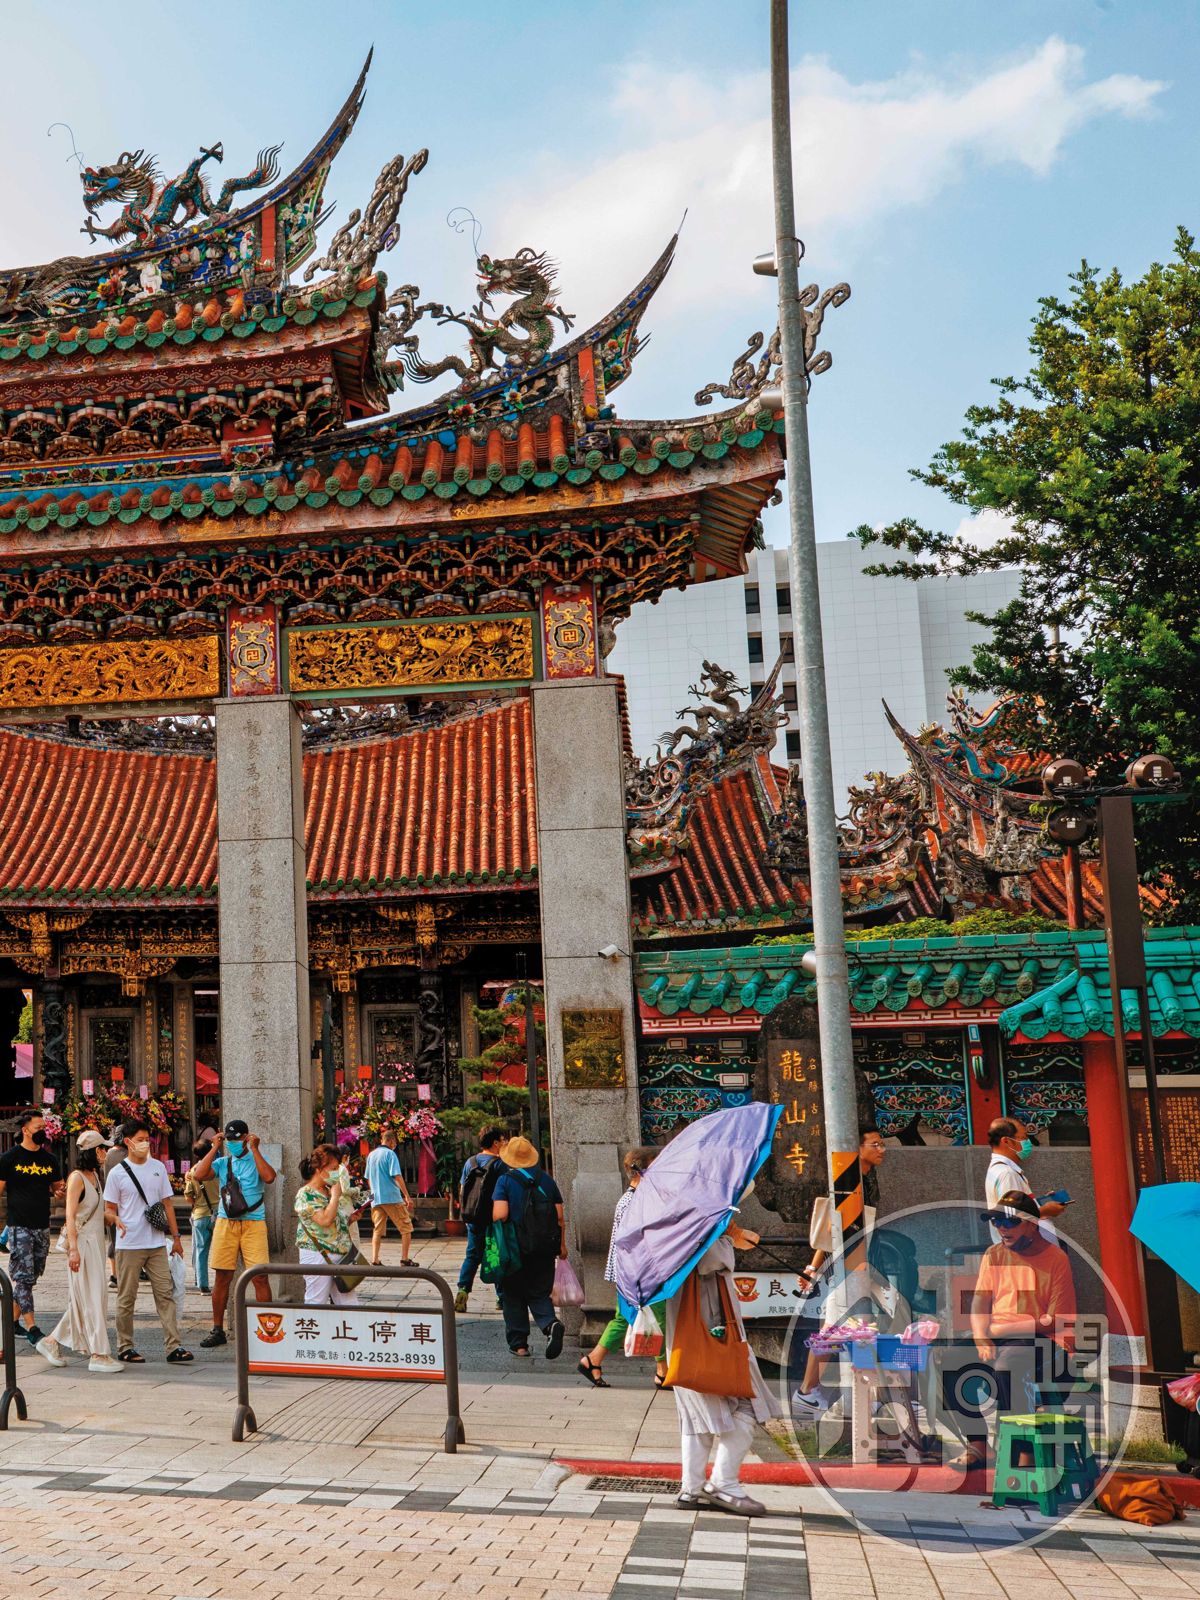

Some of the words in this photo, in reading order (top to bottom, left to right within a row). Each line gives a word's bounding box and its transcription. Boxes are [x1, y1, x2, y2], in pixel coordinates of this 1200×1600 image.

[779, 1050, 808, 1175] 龍山寺
[294, 1318, 436, 1345] 禁止停車
